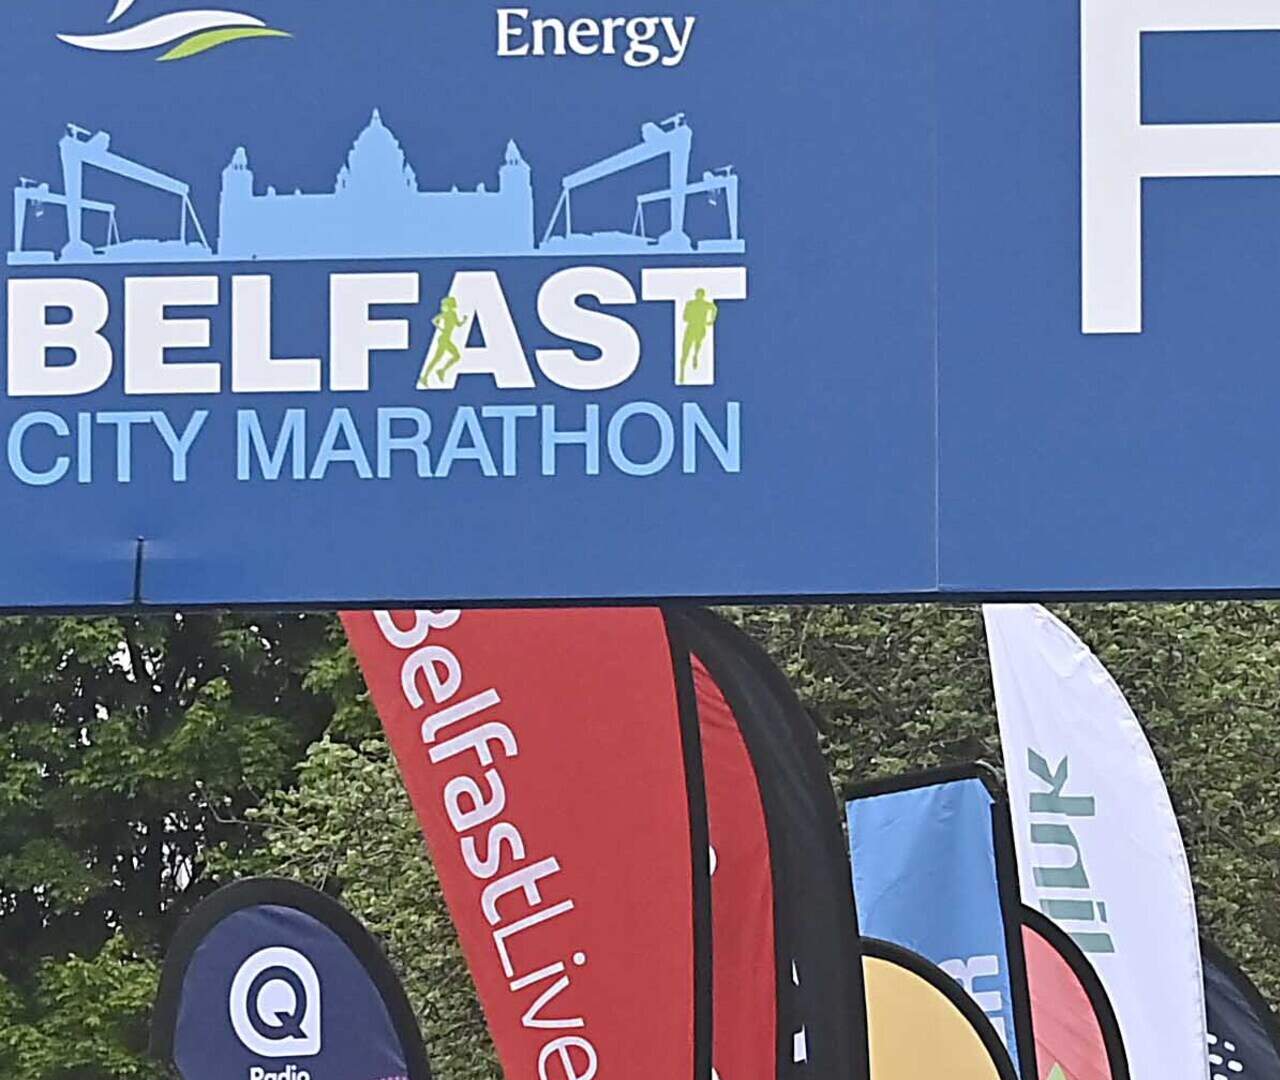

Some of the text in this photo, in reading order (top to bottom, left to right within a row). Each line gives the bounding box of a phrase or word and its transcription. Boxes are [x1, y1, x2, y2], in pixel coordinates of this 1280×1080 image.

[496, 8, 696, 67] Energy
[7, 267, 747, 396] BELFAST
[8, 402, 742, 486] CITY MARATHON
